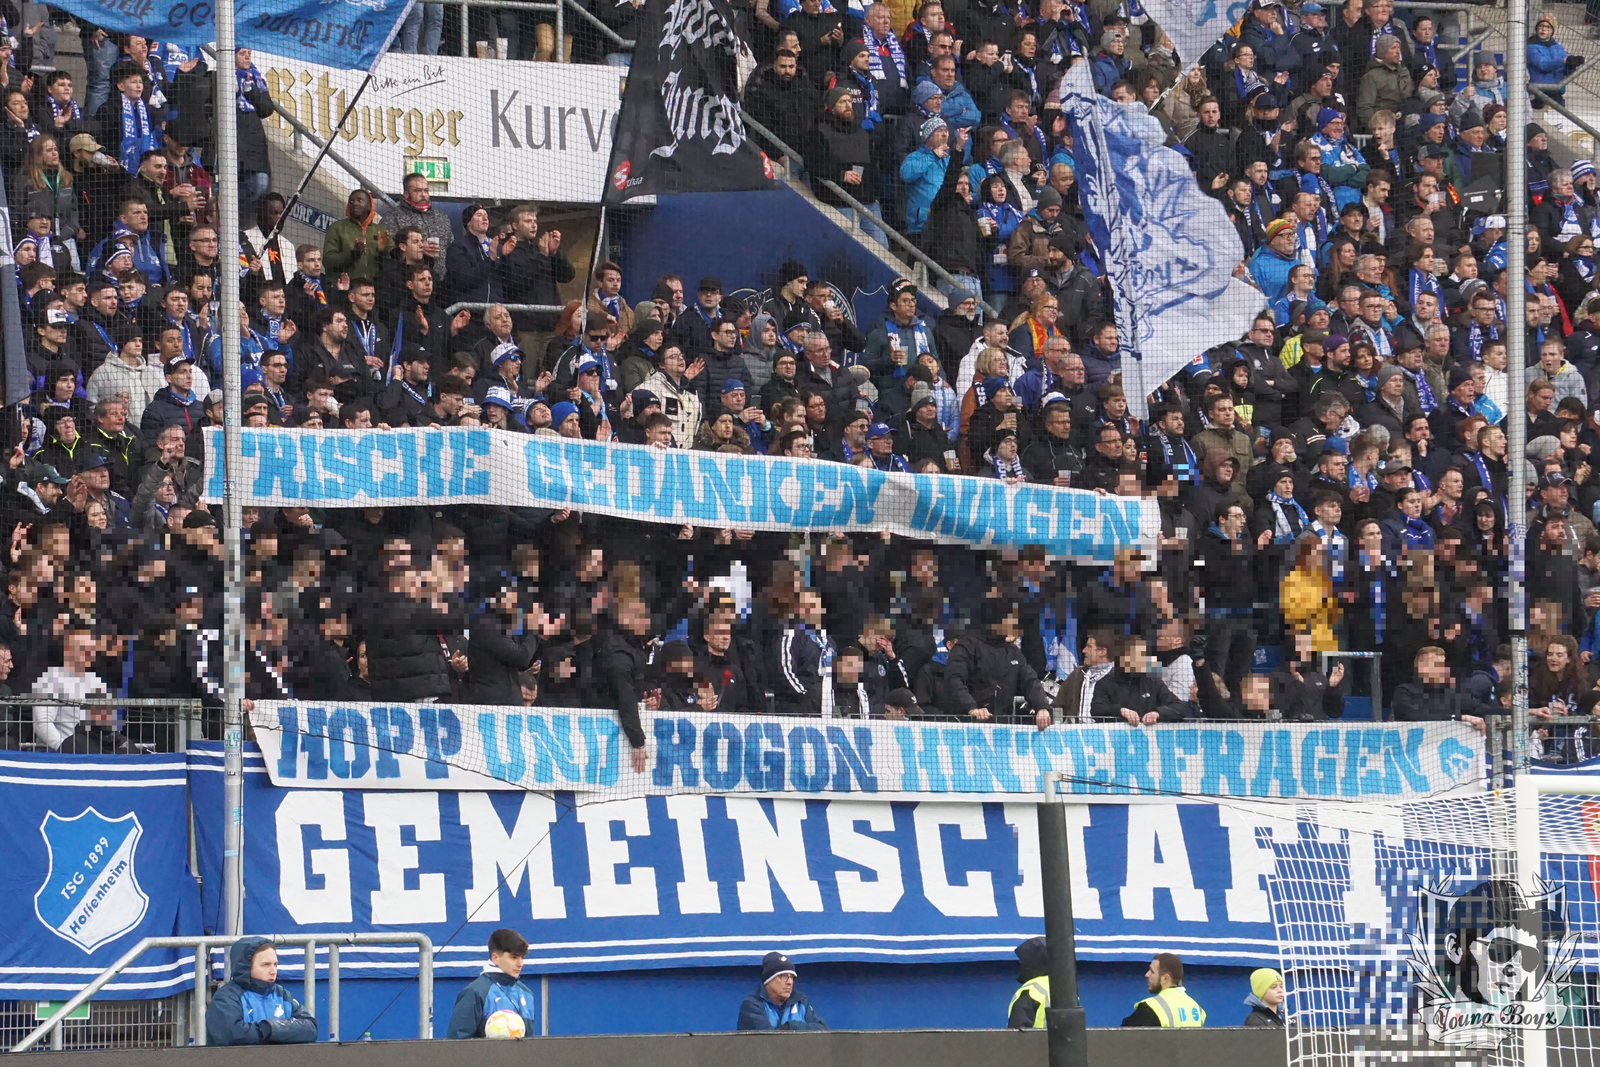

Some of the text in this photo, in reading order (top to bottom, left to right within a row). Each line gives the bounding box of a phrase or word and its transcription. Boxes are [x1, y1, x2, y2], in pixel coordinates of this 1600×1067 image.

[265, 67, 464, 156] Bitburger
[403, 74, 420, 85] ein
[423, 65, 446, 81] Bit
[523, 440, 887, 526] GEDANKEN
[911, 472, 1144, 559] WAGEN
[277, 706, 1431, 797] HOPP UND ROGON HINTERFRAGEN
[60, 836, 109, 900] TSG 1899
[68, 859, 128, 935] Hoffenheim
[275, 789, 1404, 925] GEMEINSCHAFT
